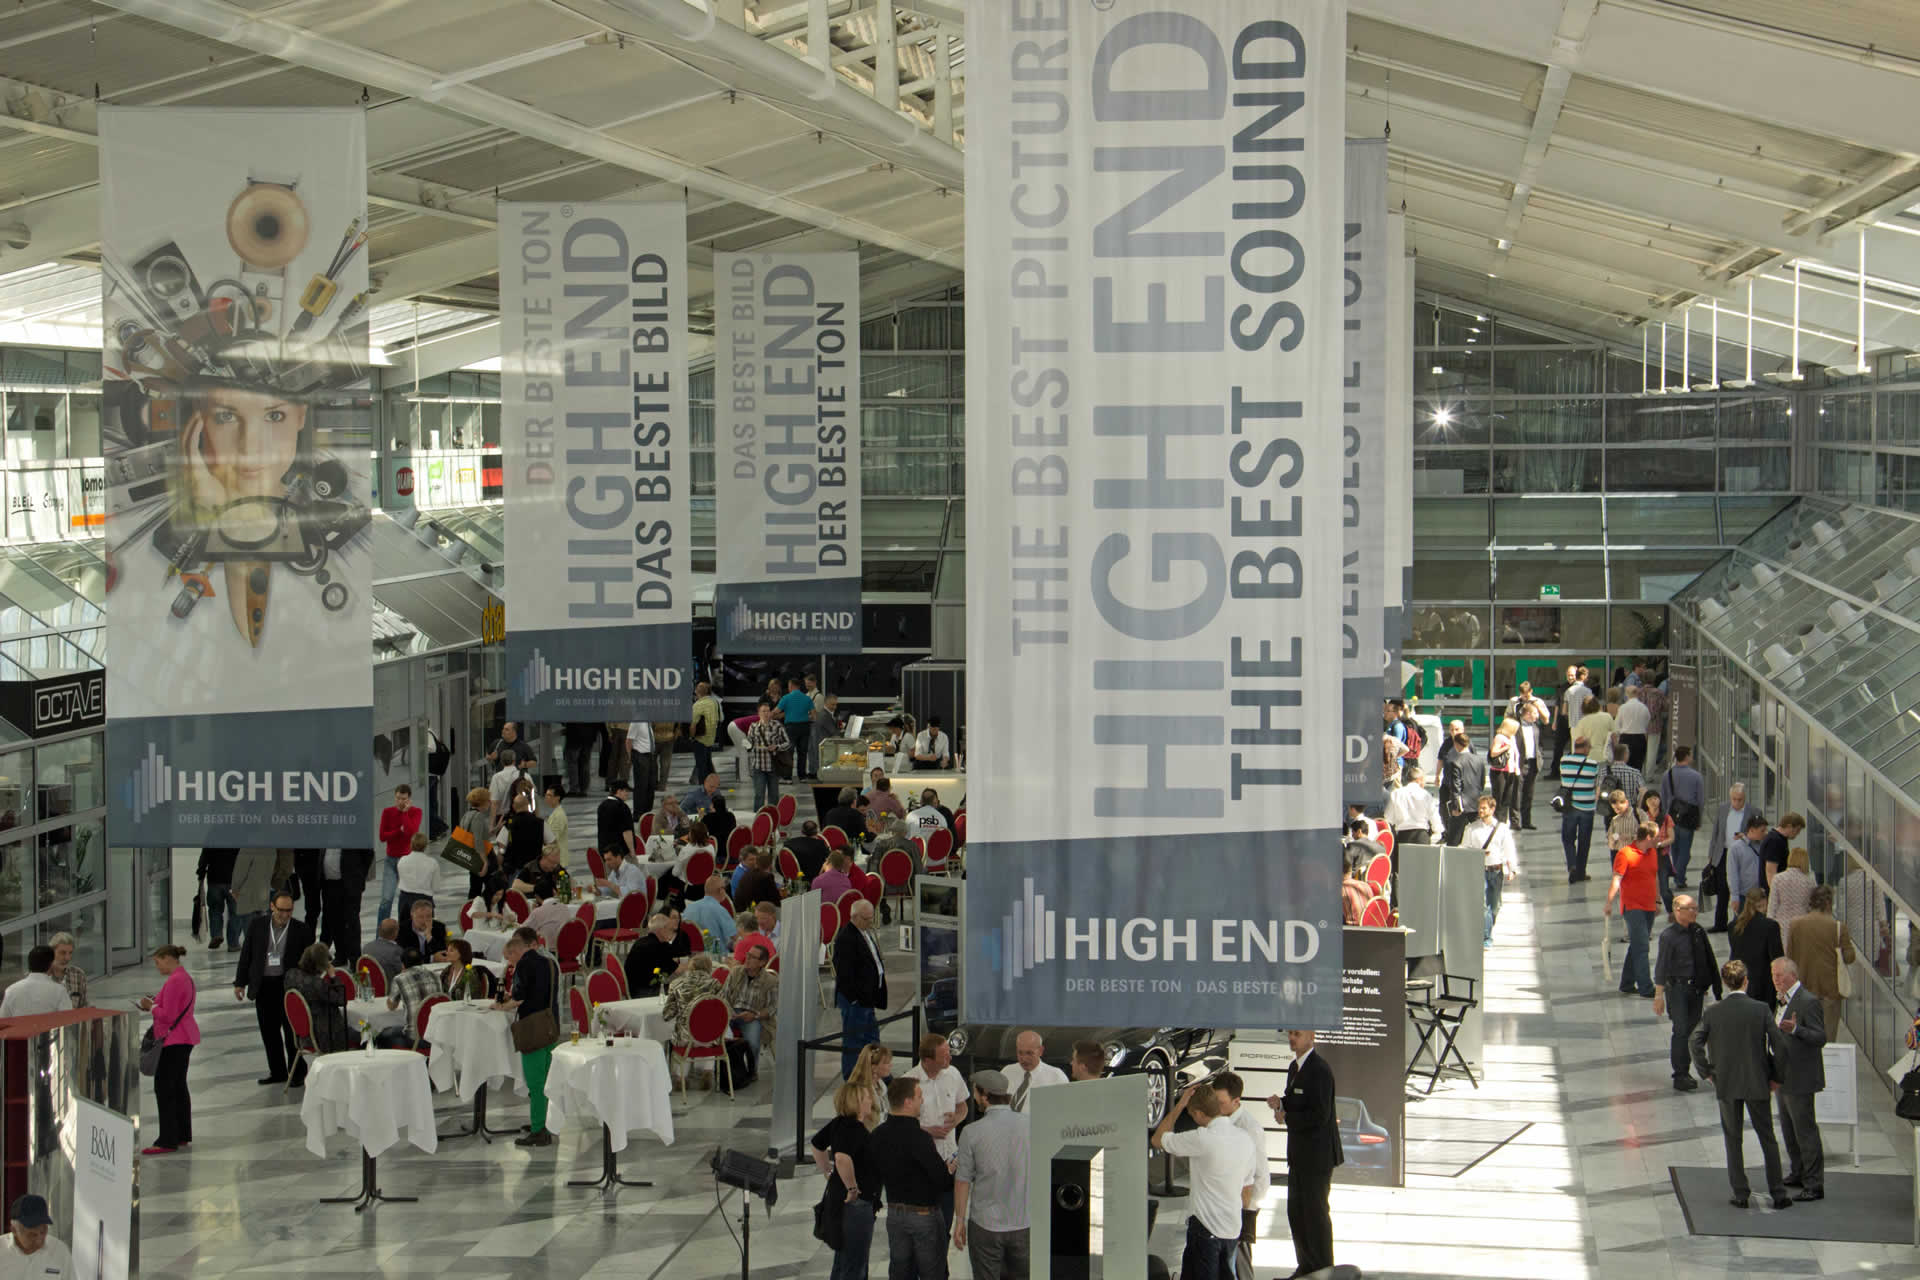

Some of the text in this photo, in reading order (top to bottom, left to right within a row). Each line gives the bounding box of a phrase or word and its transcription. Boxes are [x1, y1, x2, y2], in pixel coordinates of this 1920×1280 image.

[520, 208, 553, 486] DER BESTE TON
[731, 257, 757, 479] DAS BESTE BILD
[763, 263, 817, 396] END
[1010, 0, 1070, 656] THE BEST PICTURE
[562, 217, 634, 619] HIGH END
[631, 253, 673, 610] DAS BESTE BILD
[816, 302, 847, 567] DER BESTE TON
[1090, 8, 1228, 819] HIGH END
[1230, 20, 1306, 801] THE BEST SOUND
[764, 414, 818, 575] HIGH
[754, 612, 854, 631] HIGH END
[38, 682, 102, 721] OCTAVE
[555, 667, 682, 691] HIGH END
[178, 770, 358, 802] HIGH END
[179, 813, 357, 825] DER BESTE TON DAS BESTE BILD
[919, 815, 939, 828] psb
[1065, 917, 1320, 964] HIGH END
[1066, 978, 1095, 992] DER
[1101, 978, 1145, 993] BESTE
[1151, 979, 1182, 993] TON
[1197, 980, 1228, 994] DAS
[1233, 980, 1278, 995] BESTE
[1364, 987, 1380, 995] Welt.
[91, 1125, 115, 1166] B&M
